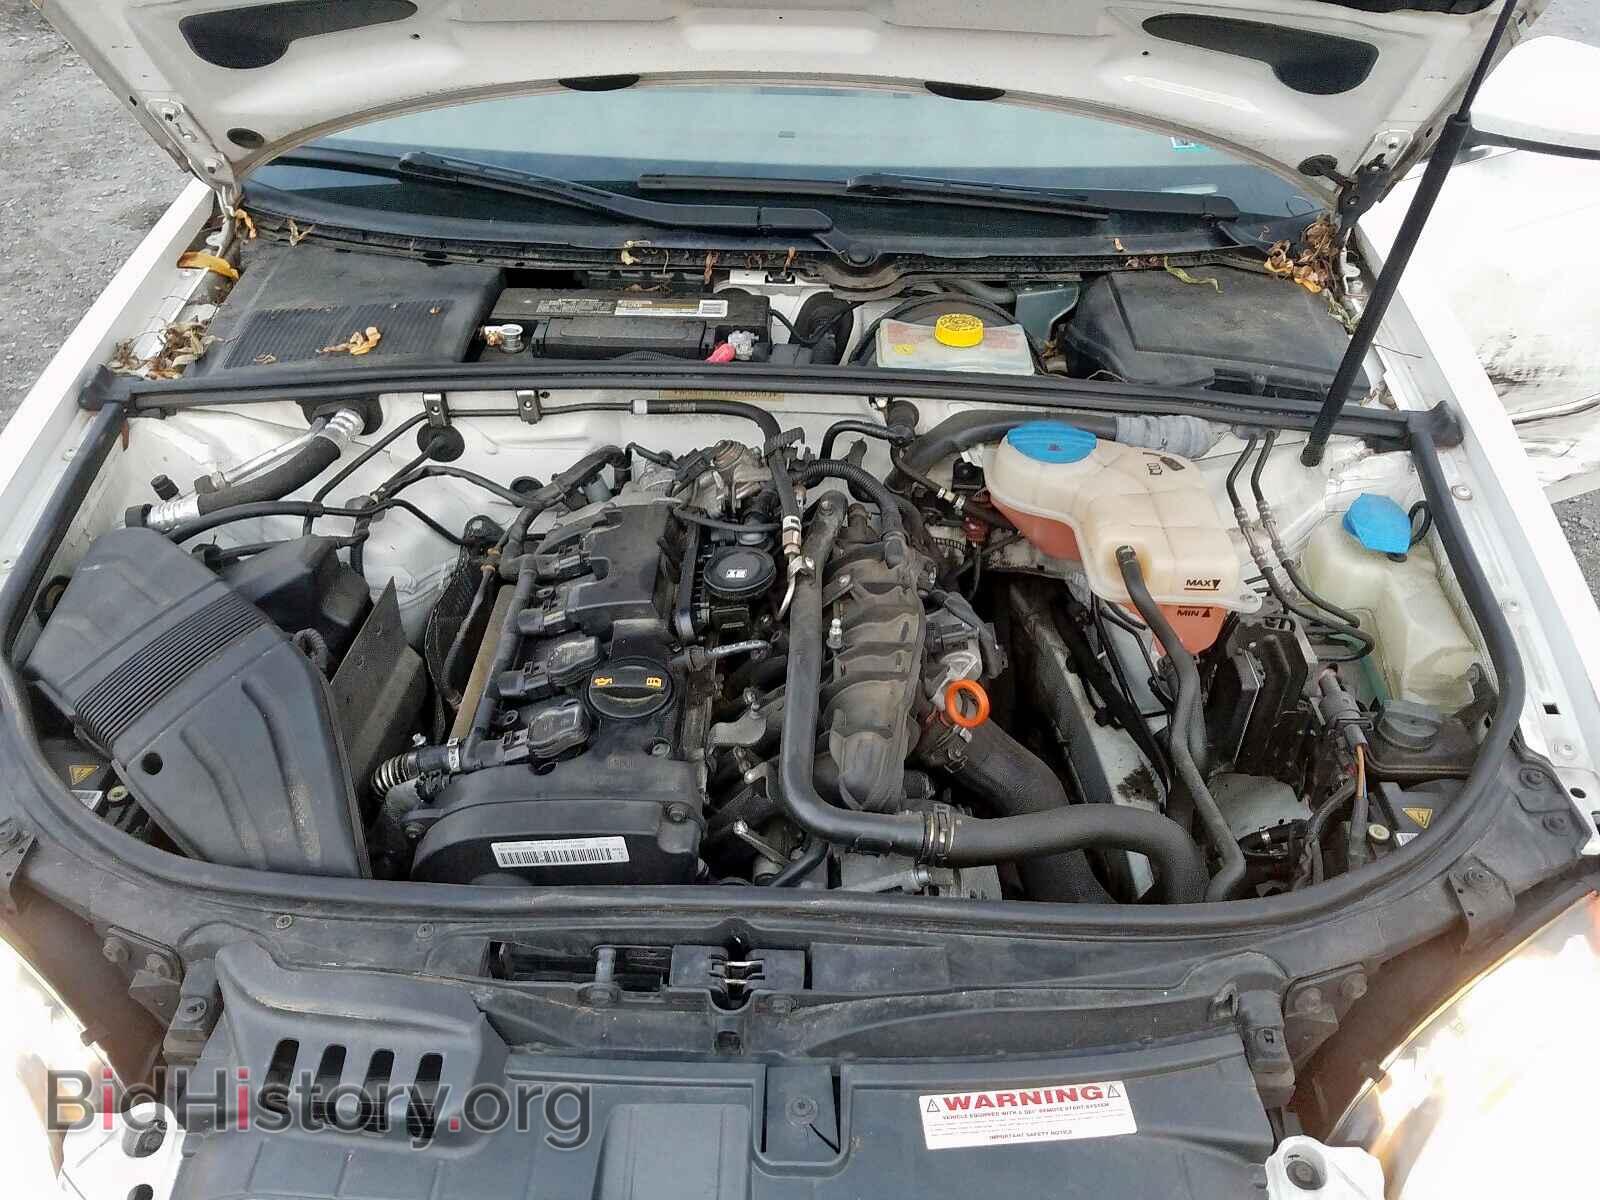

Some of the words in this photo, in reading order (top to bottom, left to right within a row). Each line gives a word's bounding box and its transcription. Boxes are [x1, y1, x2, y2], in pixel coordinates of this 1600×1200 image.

[1185, 579, 1211, 587] MAX
[1176, 609, 1199, 617] MIN
[943, 1086, 1104, 1111] WARNING
[989, 1132, 1024, 1140] IMPORTANT
[1026, 1130, 1049, 1138] SAFETY
